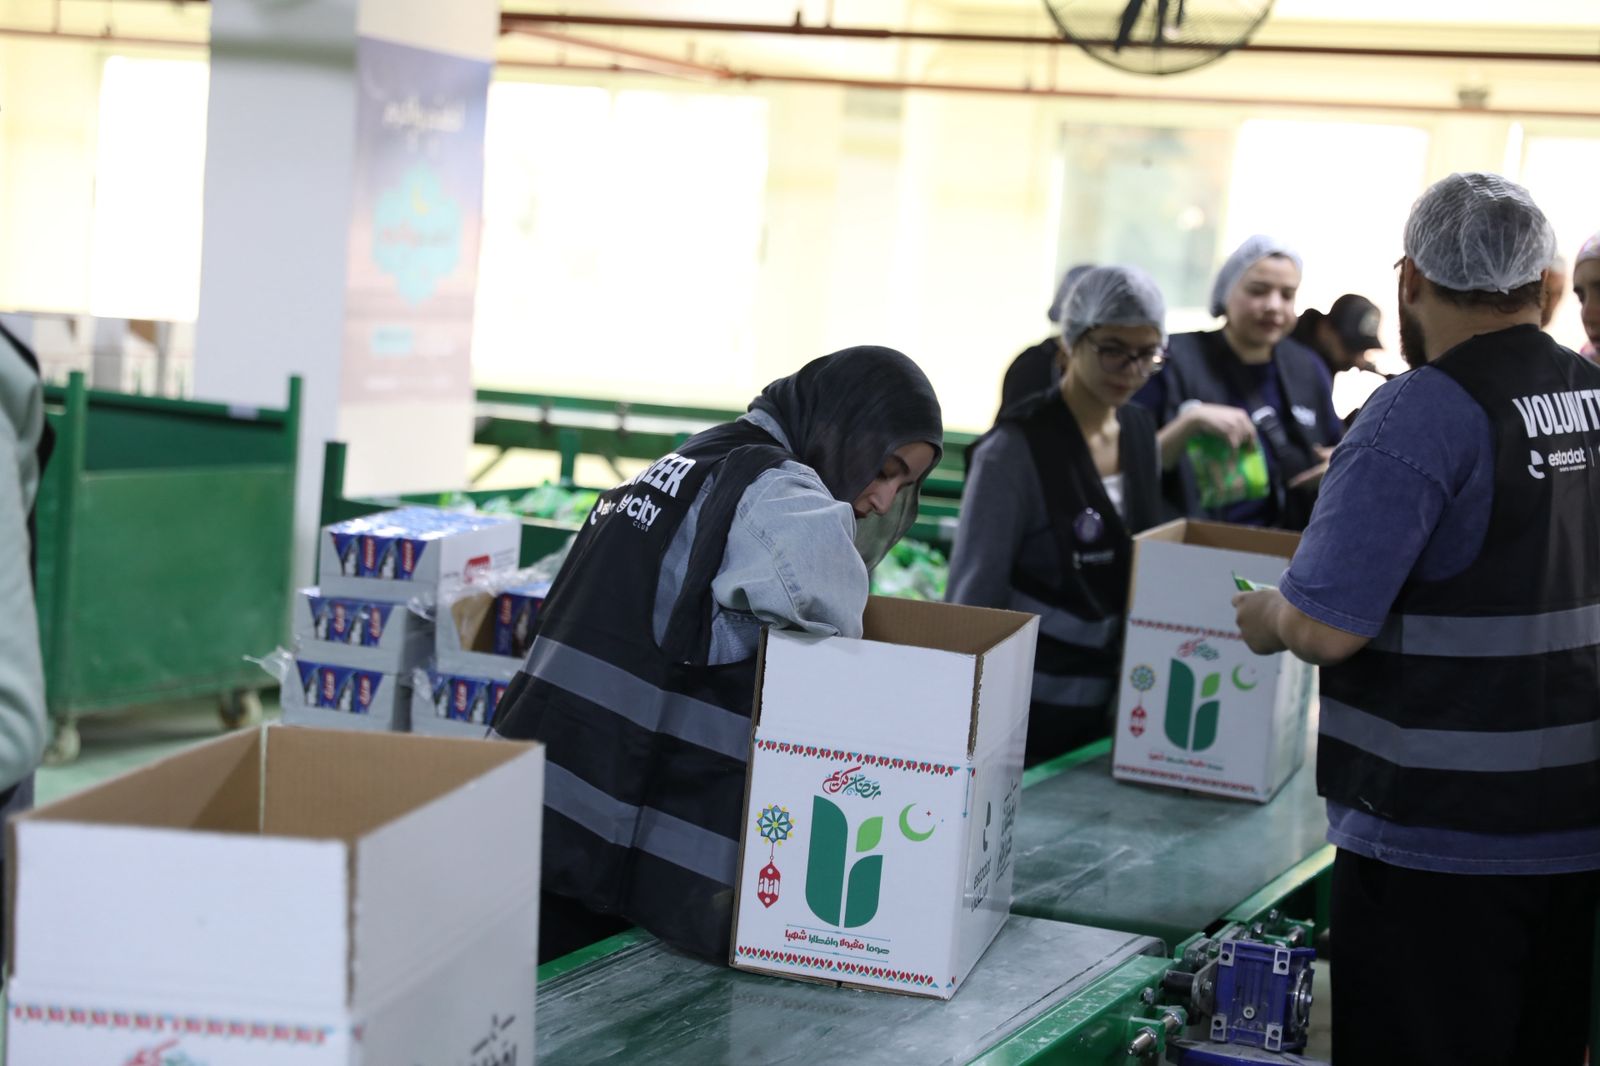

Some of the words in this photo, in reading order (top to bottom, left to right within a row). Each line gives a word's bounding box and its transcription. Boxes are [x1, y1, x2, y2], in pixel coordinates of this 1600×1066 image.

[626, 494, 662, 527] city
[841, 774, 882, 801] رمضان
[784, 929, 808, 941] شهيا
[839, 938, 865, 950] مقبولا
[866, 943, 890, 955] صوما
